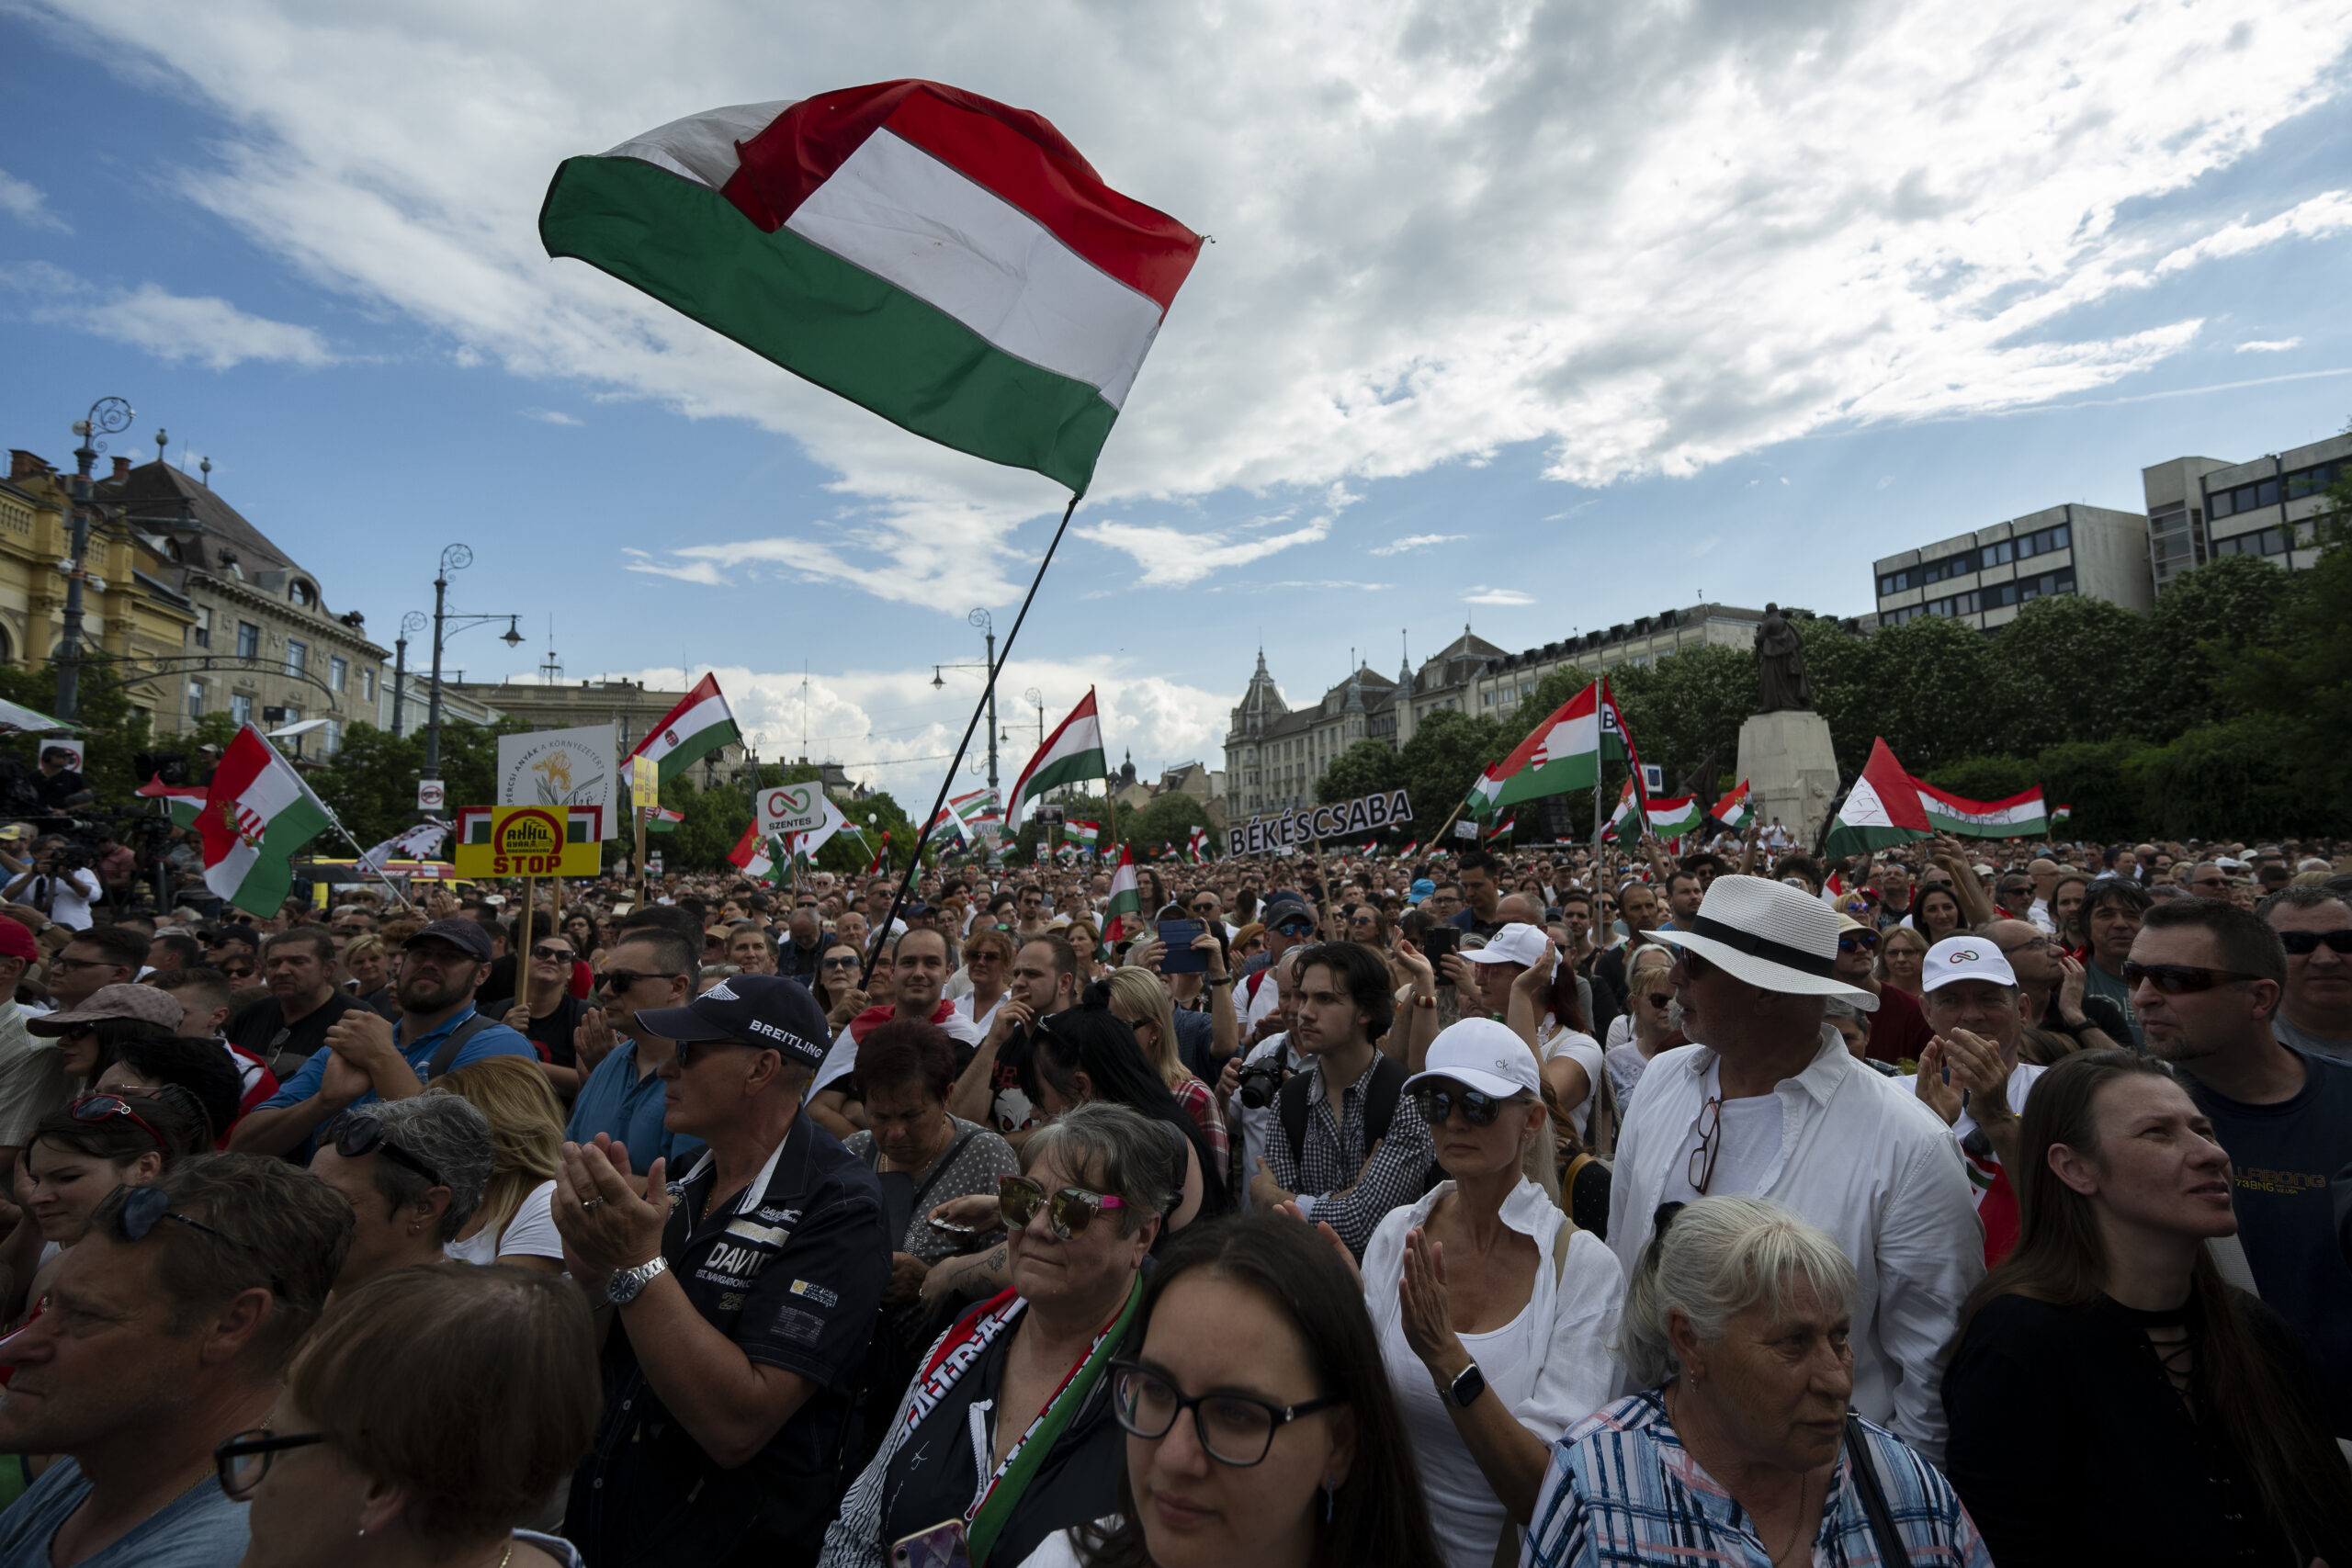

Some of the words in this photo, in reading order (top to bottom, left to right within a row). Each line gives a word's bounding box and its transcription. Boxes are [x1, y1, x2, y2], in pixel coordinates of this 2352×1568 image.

[514, 747, 538, 772] ANYÁK
[549, 739, 605, 770] KÖRNYEZETÉRT
[769, 817, 812, 830] SZENTES
[1229, 791, 1411, 857] BÉKÉSCSABA
[493, 855, 561, 874] STOP
[749, 1019, 823, 1058] BREITLING
[1495, 1059, 1509, 1071] ck
